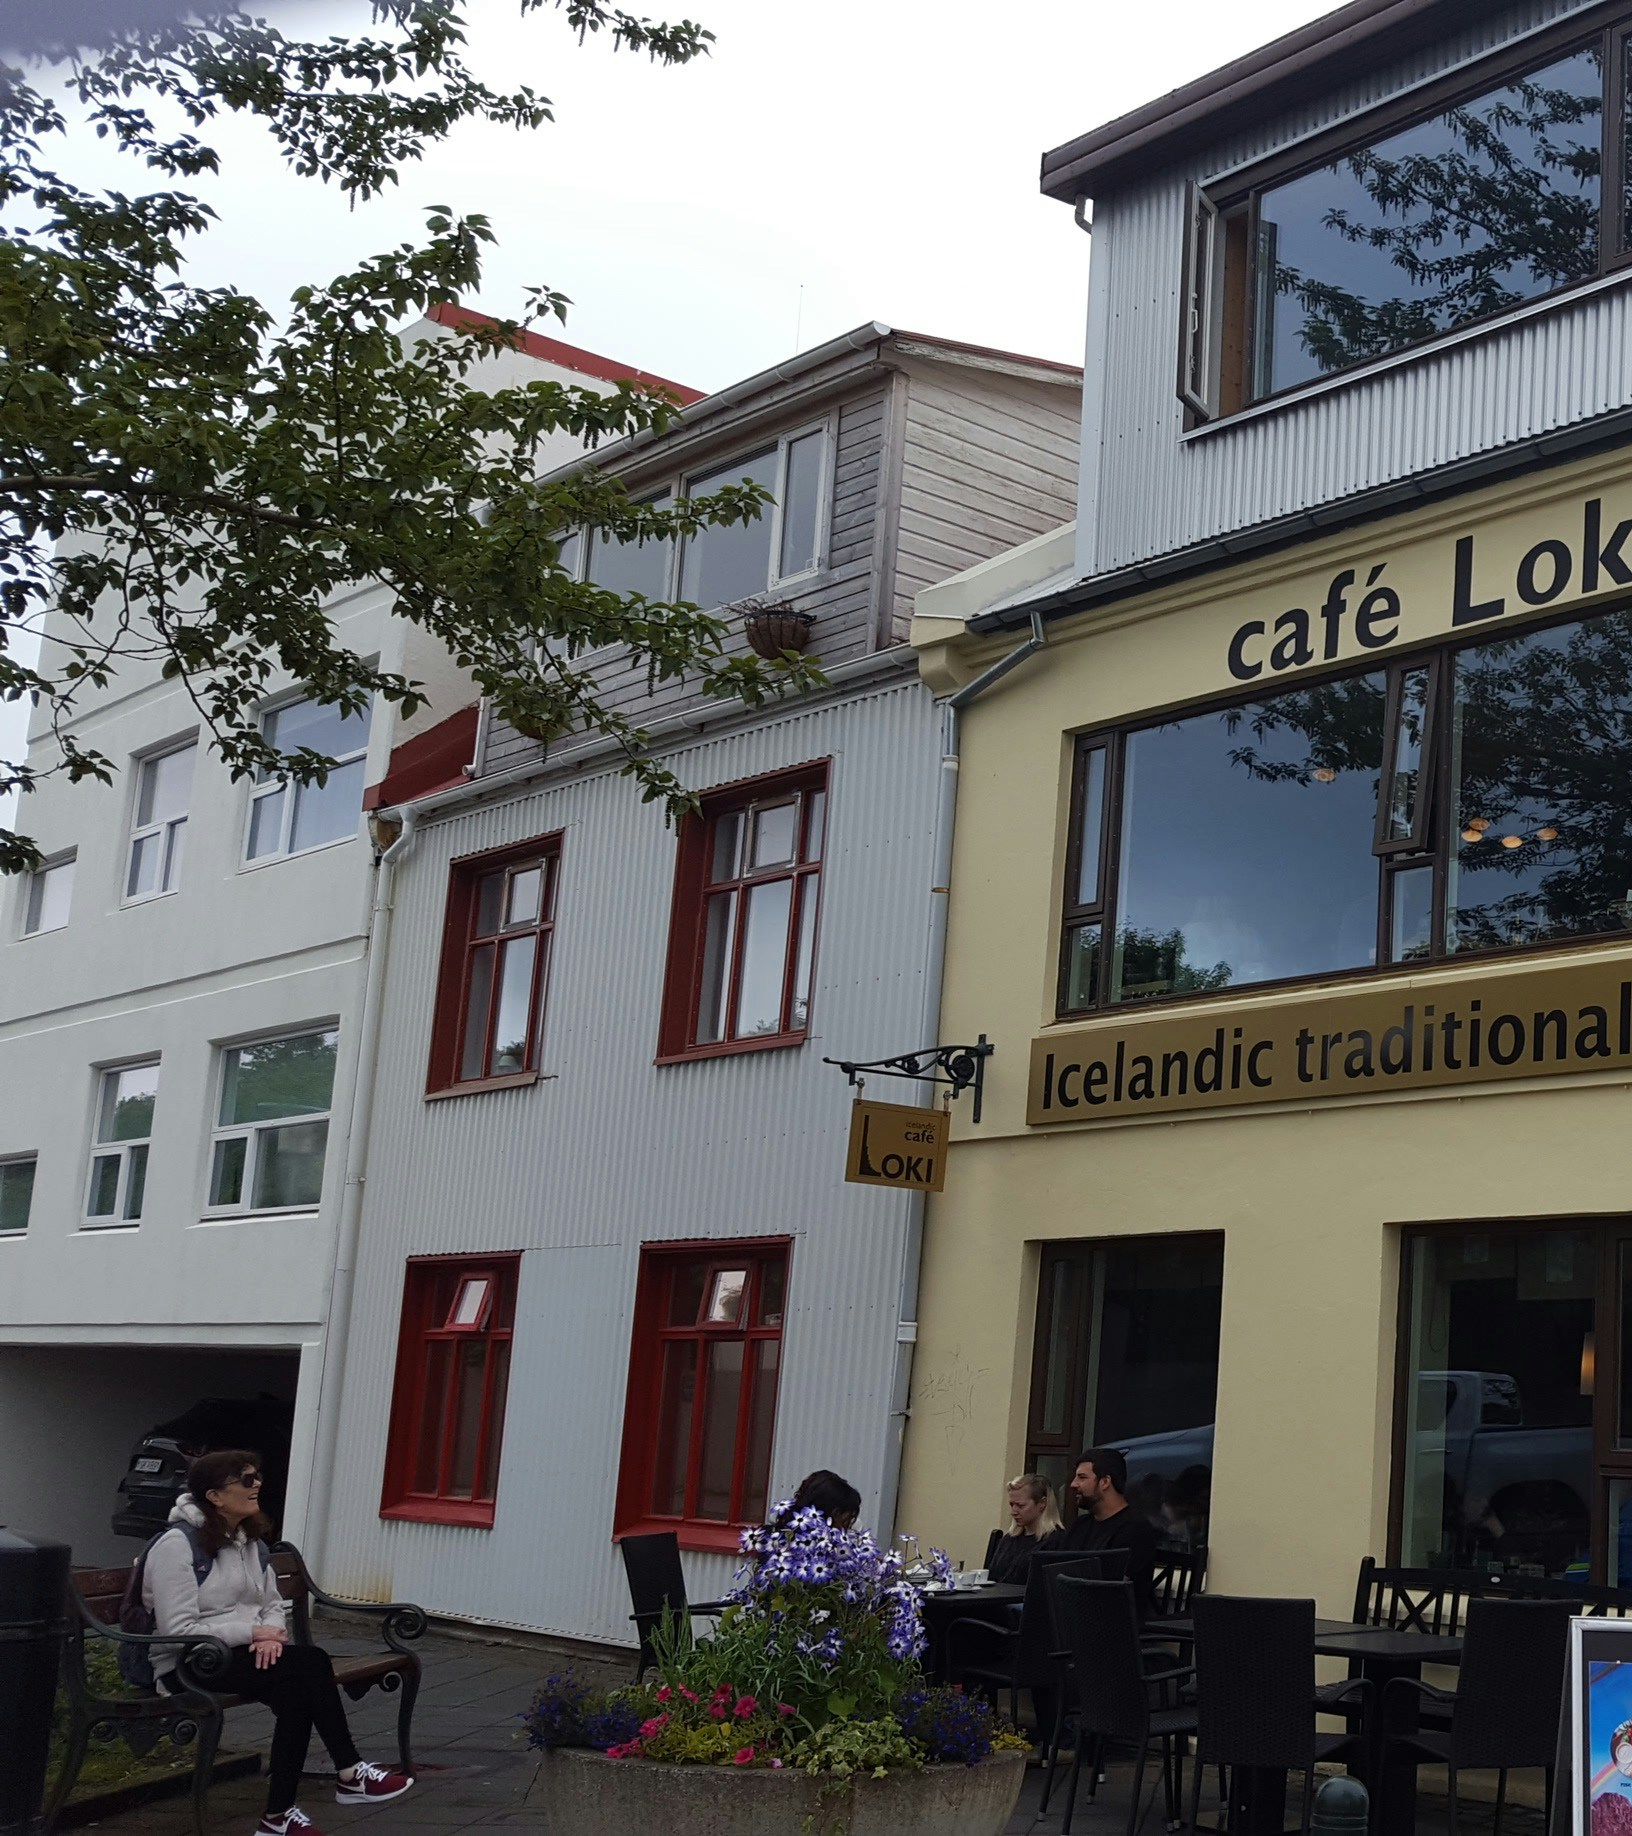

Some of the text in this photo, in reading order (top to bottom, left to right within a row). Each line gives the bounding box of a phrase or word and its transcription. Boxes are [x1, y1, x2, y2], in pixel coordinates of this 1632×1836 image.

[1227, 562, 1401, 681] café
[1042, 1026, 1274, 1110] Icelandic
[1295, 981, 1632, 1084] traditional
[858, 1114, 934, 1184] LOKI
[904, 1129, 935, 1144] café
